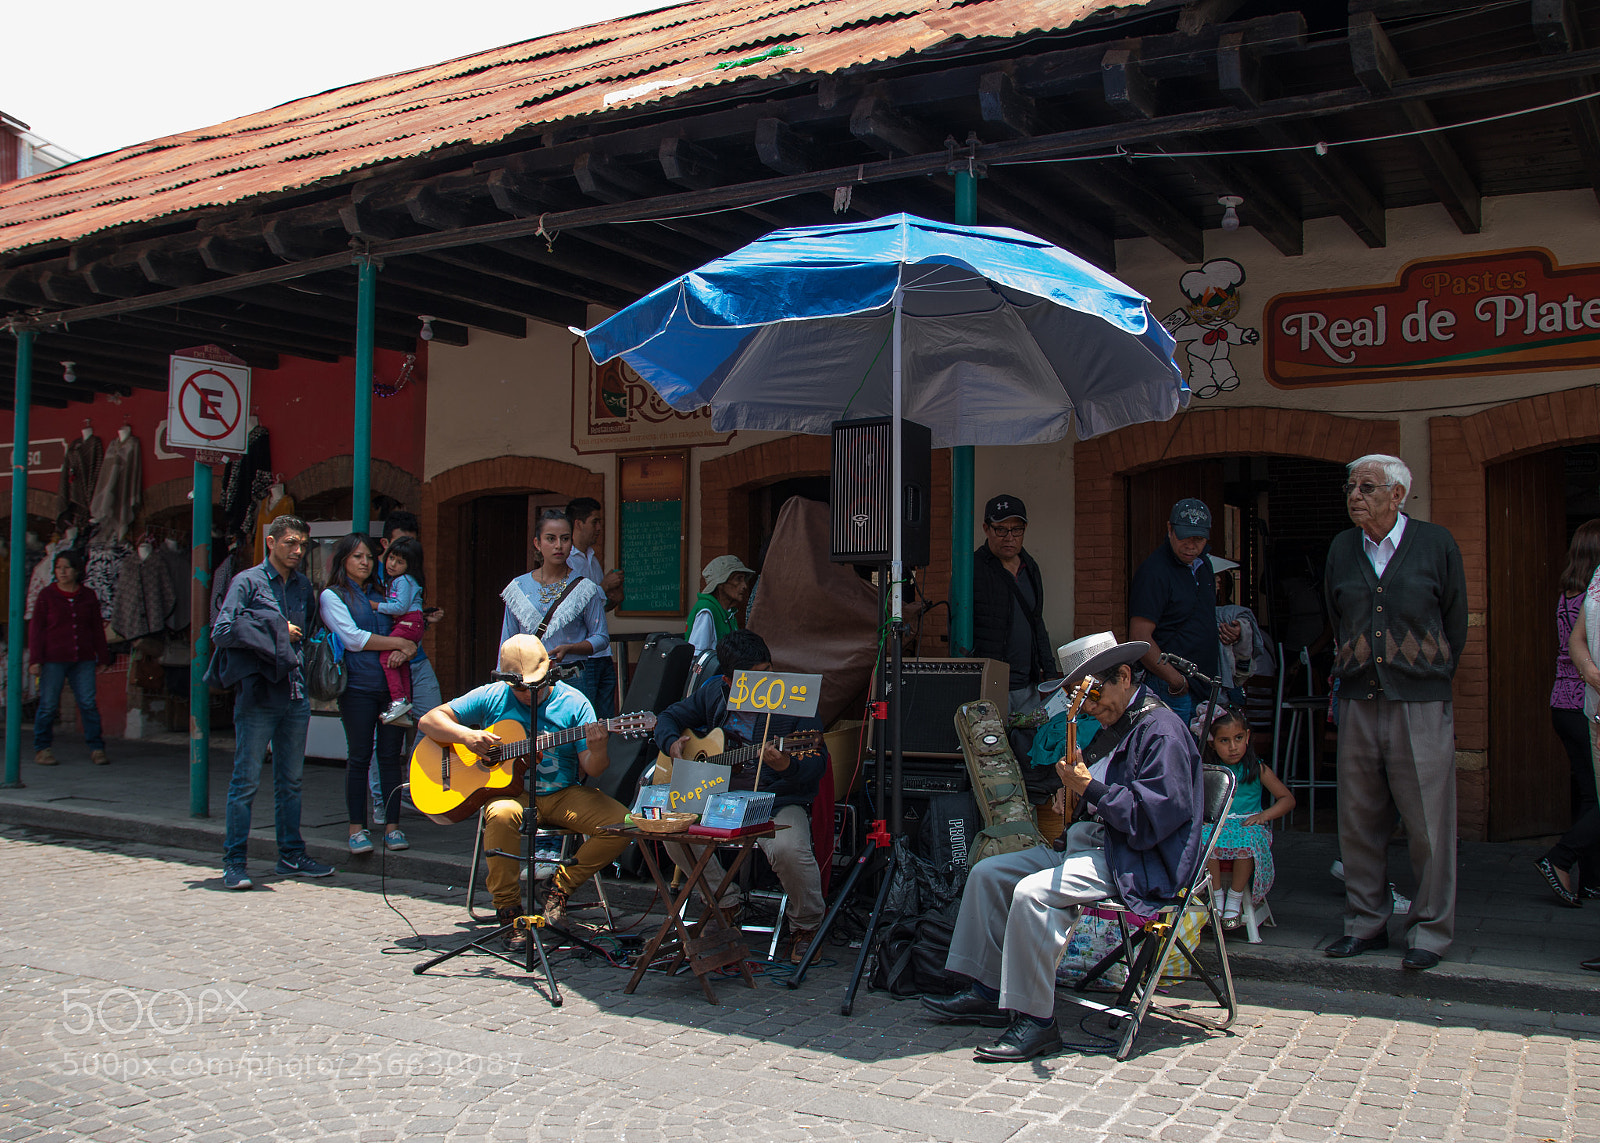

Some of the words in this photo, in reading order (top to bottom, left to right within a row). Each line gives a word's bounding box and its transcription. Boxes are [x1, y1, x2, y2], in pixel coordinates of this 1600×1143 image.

[1422, 270, 1528, 297] Pastes
[1281, 305, 1387, 364] Real
[1402, 300, 1457, 343] de
[199, 388, 223, 421] E
[669, 776, 725, 809] Propina
